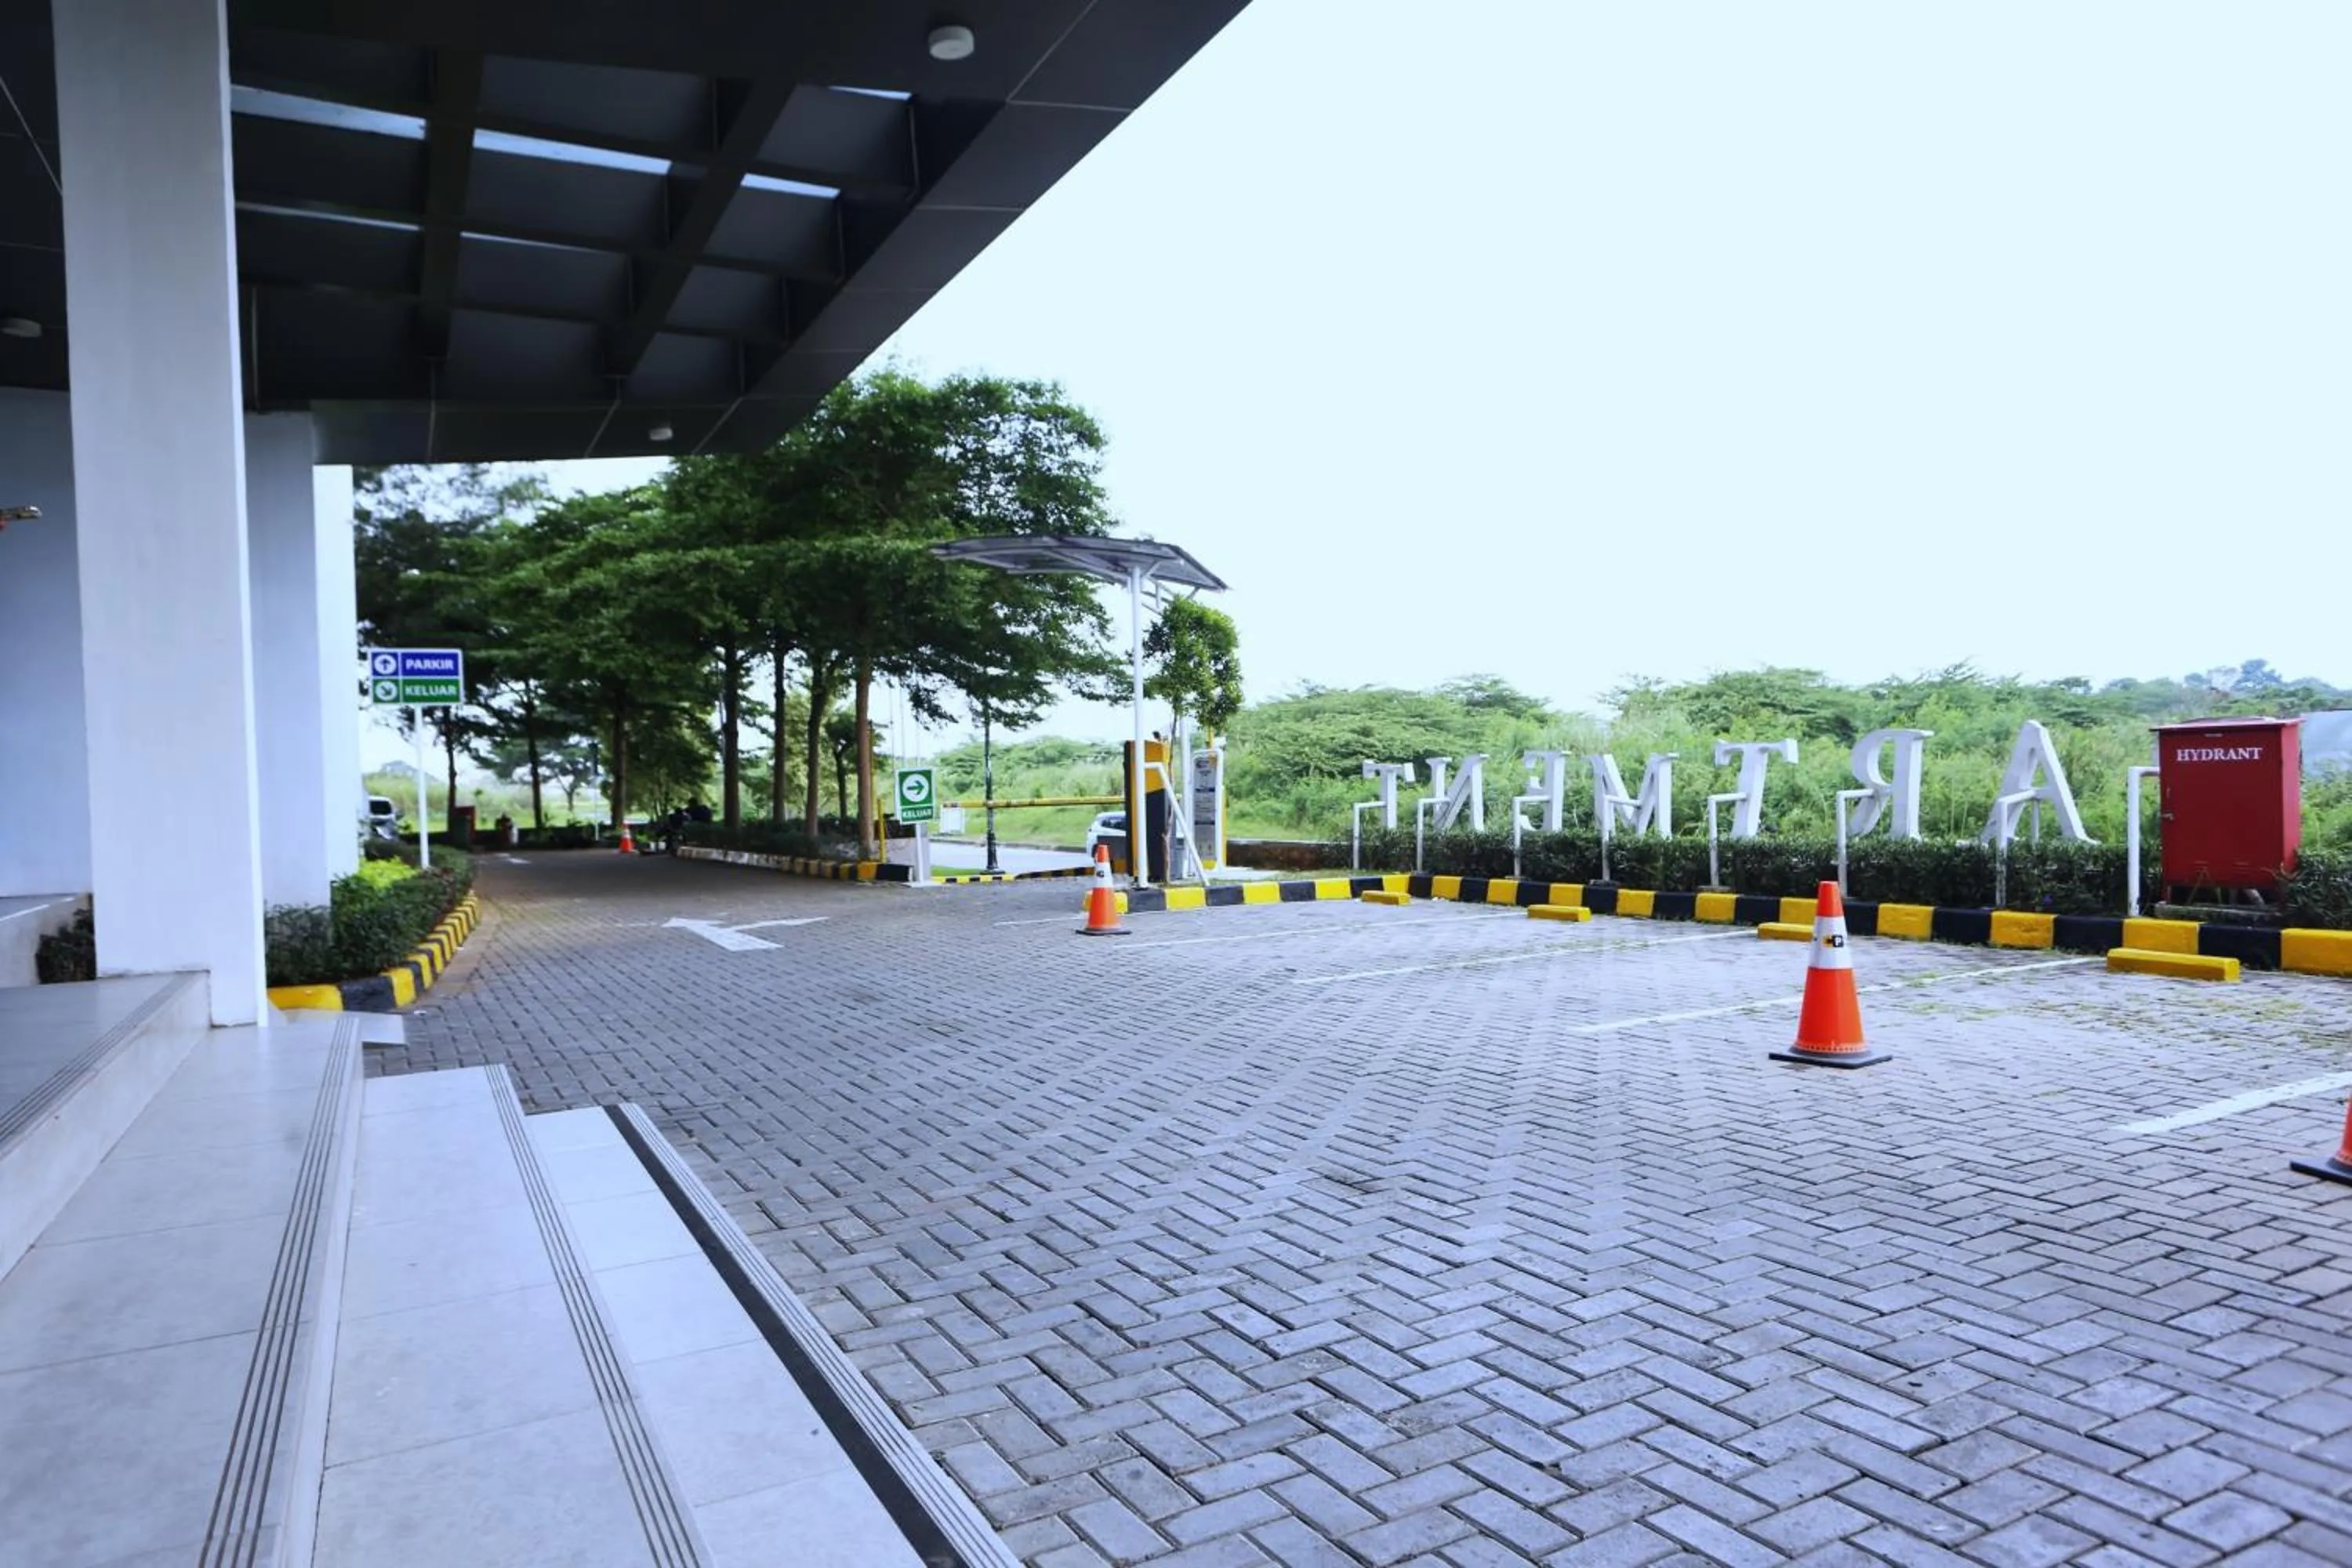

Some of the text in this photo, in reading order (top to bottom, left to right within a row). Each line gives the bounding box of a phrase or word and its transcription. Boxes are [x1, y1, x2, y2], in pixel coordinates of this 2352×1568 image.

[405, 659, 454, 670] PARKIR
[405, 684, 457, 696] KELUAR
[2176, 747, 2263, 762] HYDRANT
[902, 808, 932, 818] KELUAR
